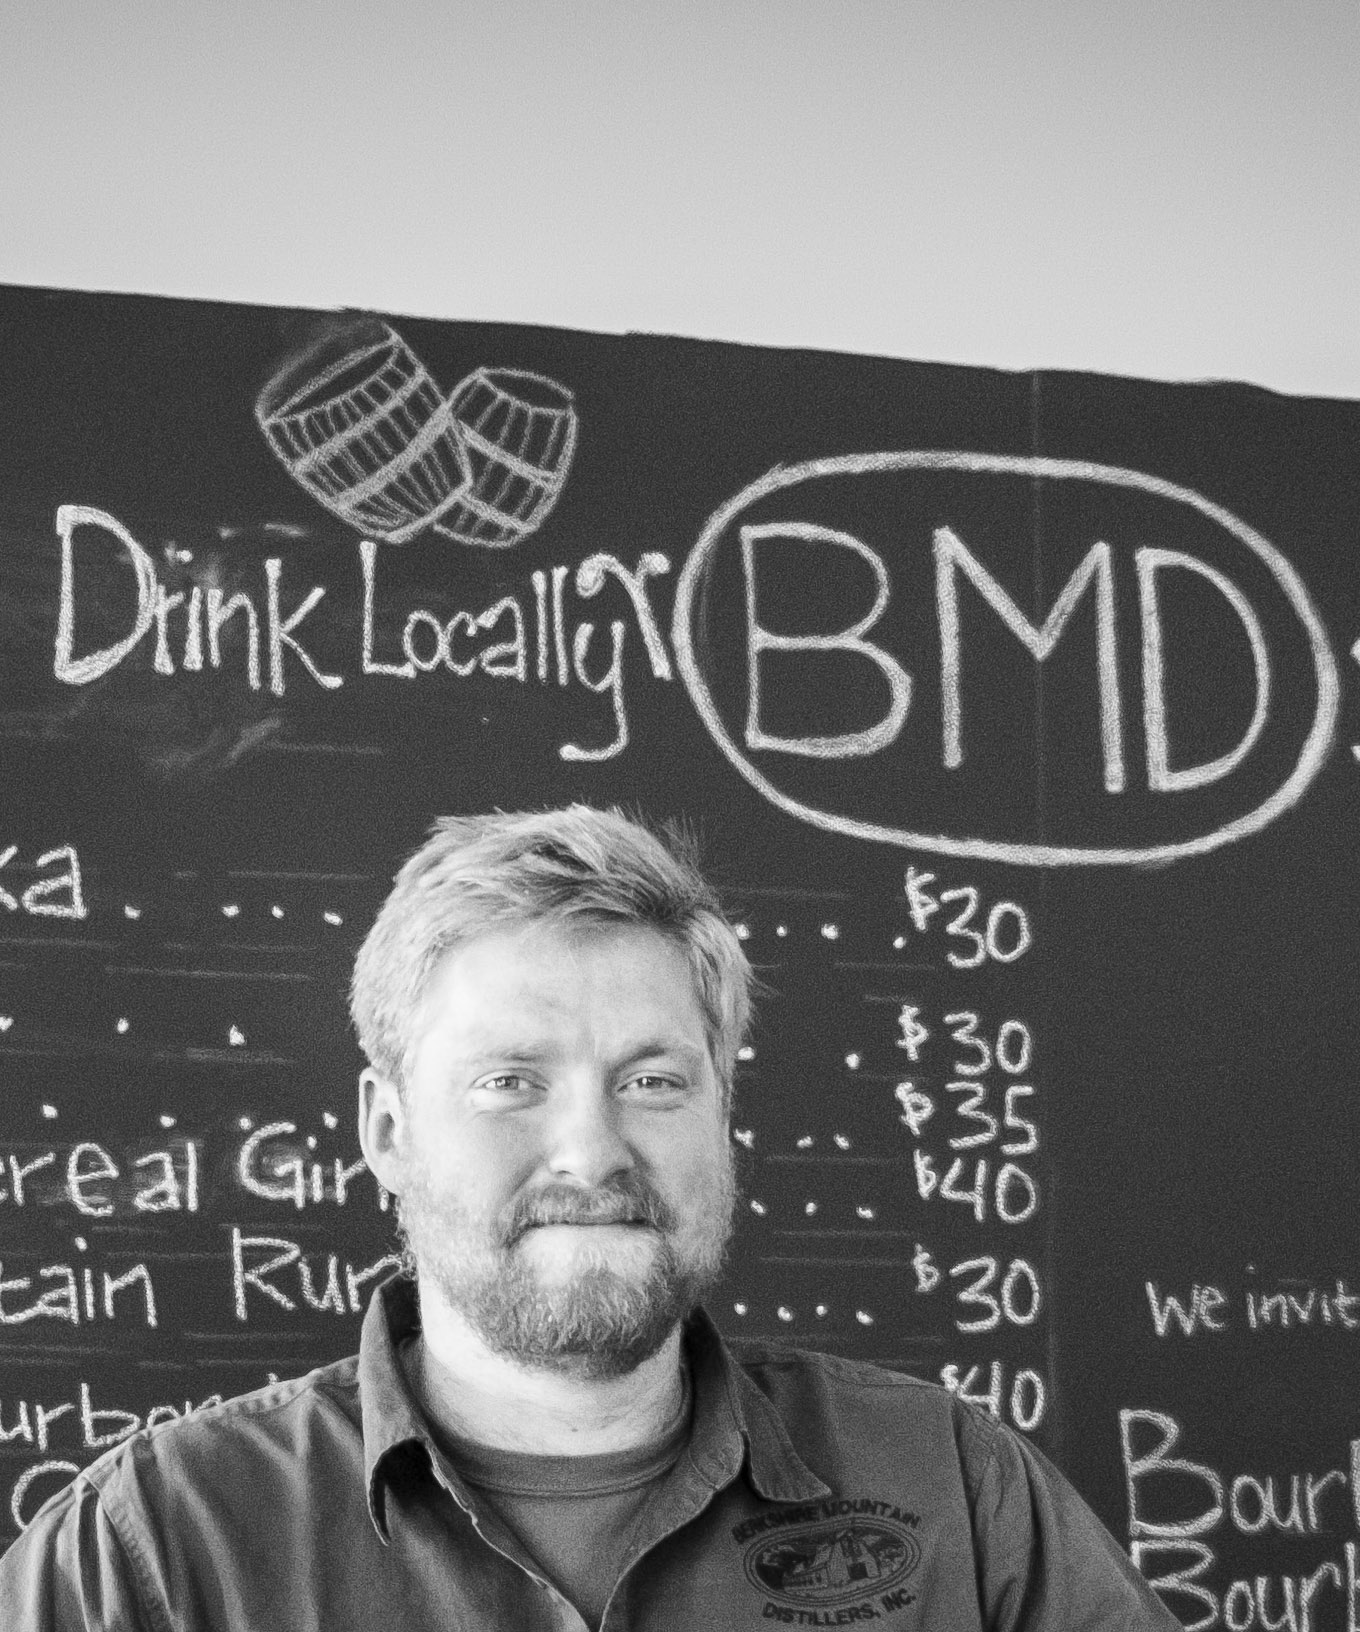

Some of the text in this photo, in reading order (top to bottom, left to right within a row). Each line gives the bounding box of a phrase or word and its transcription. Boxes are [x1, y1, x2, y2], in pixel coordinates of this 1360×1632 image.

[54, 505, 342, 696] Drink
[360, 541, 628, 762] Locally
[740, 522, 1270, 793] BMD
[904, 865, 1032, 969] $30
[896, 1004, 1032, 1076] $30
[913, 1148, 1038, 1224] $40
[913, 1244, 1040, 1333] $30
[1145, 1281, 1227, 1337] We
[821, 1499, 921, 1529] MOUNTAIN
